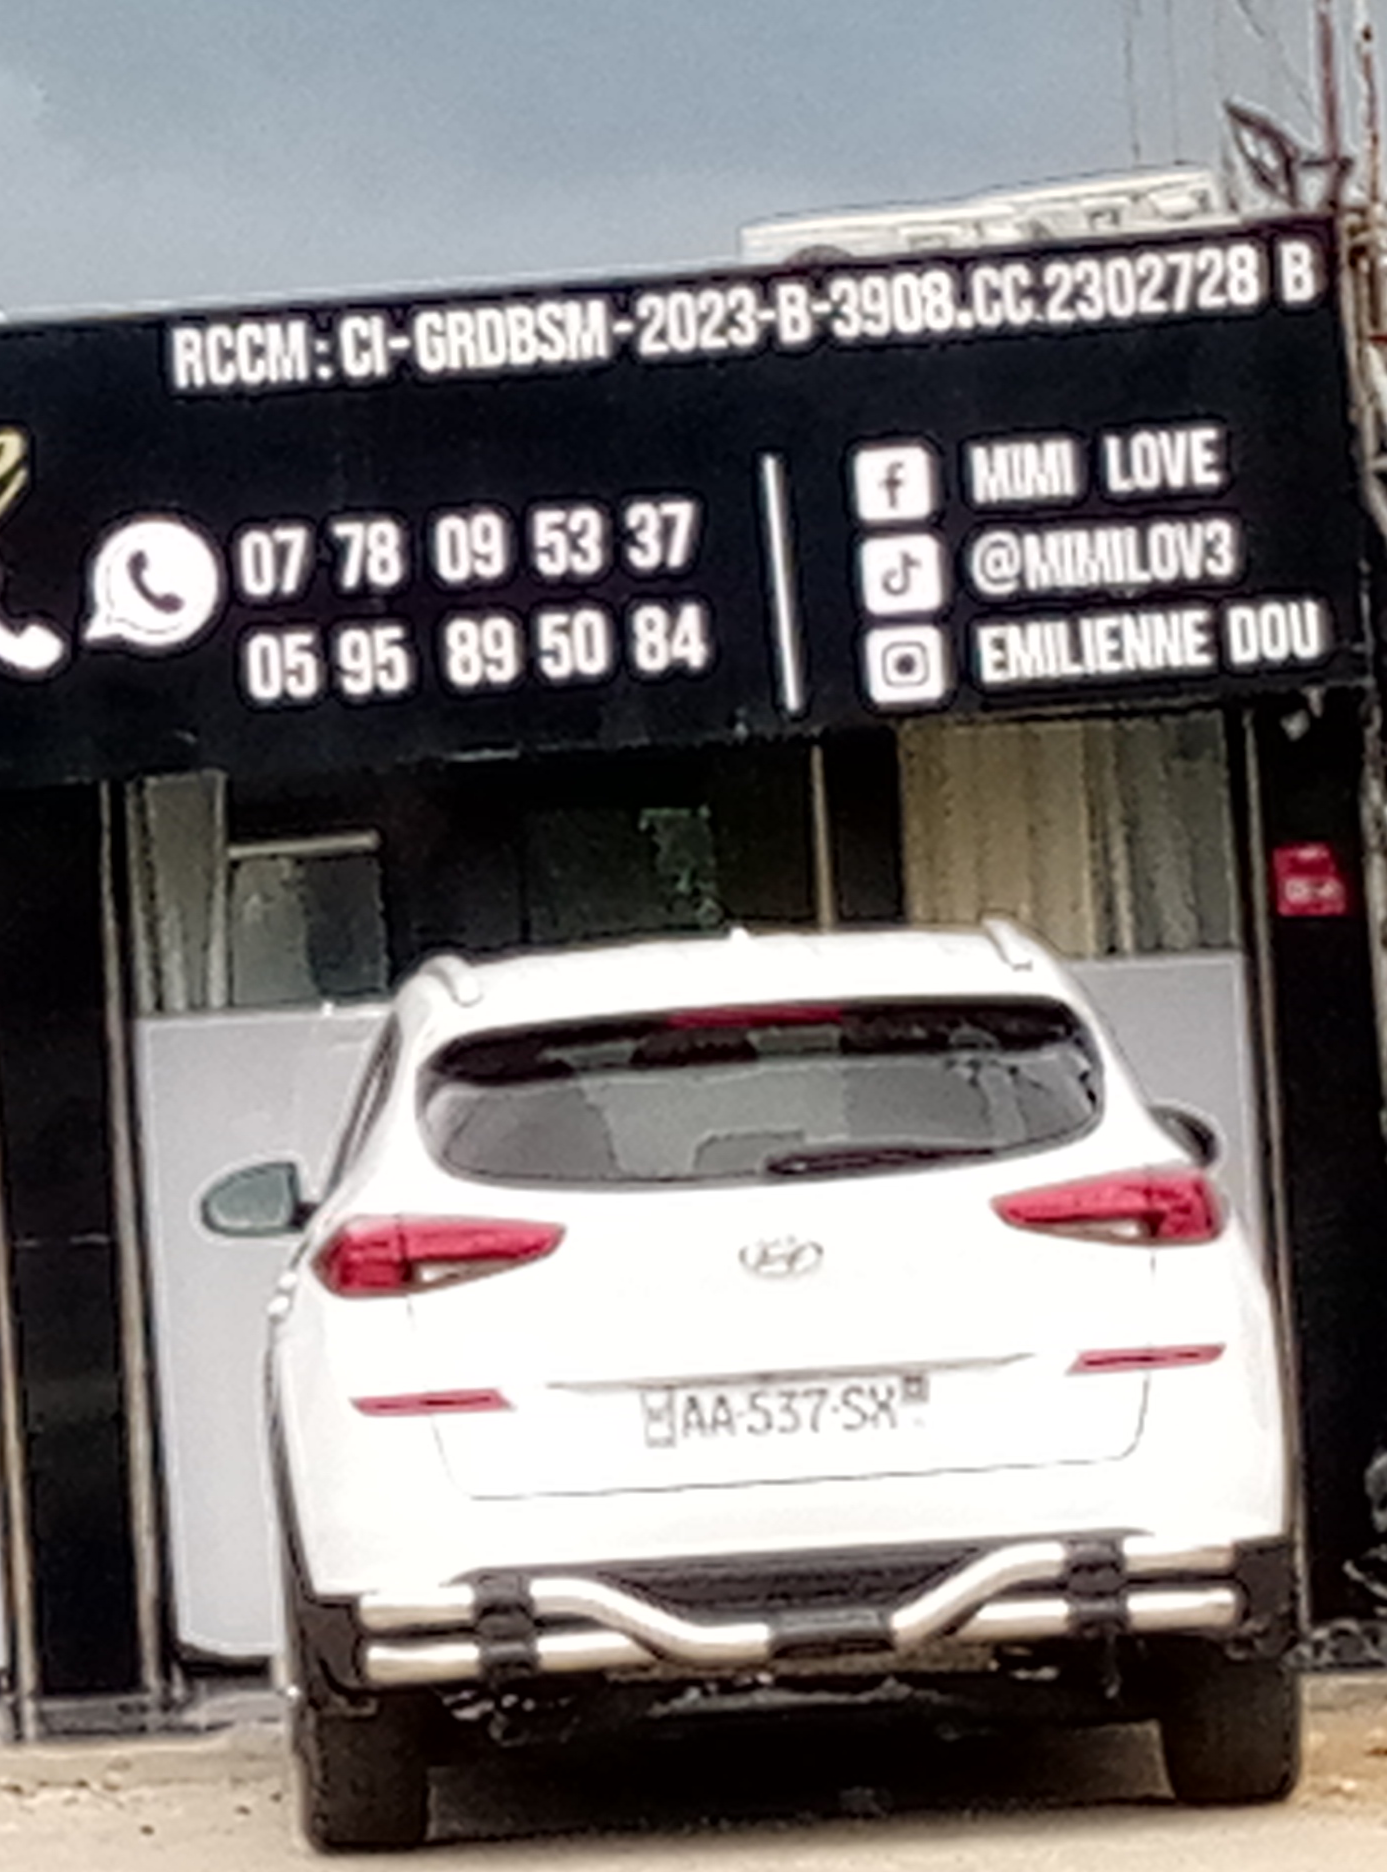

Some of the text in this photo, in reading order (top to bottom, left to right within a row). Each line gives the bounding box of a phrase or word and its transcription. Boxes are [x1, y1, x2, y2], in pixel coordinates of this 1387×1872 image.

[1278, 240, 1316, 302] B
[969, 426, 1221, 504] MIMI LOVE
[239, 500, 698, 598] 07 78 09 53 37
[969, 519, 1237, 596] @MIMILOV3
[246, 601, 711, 703] 05 95 89 50 84
[976, 600, 1321, 686] EMILIENNE DOU
